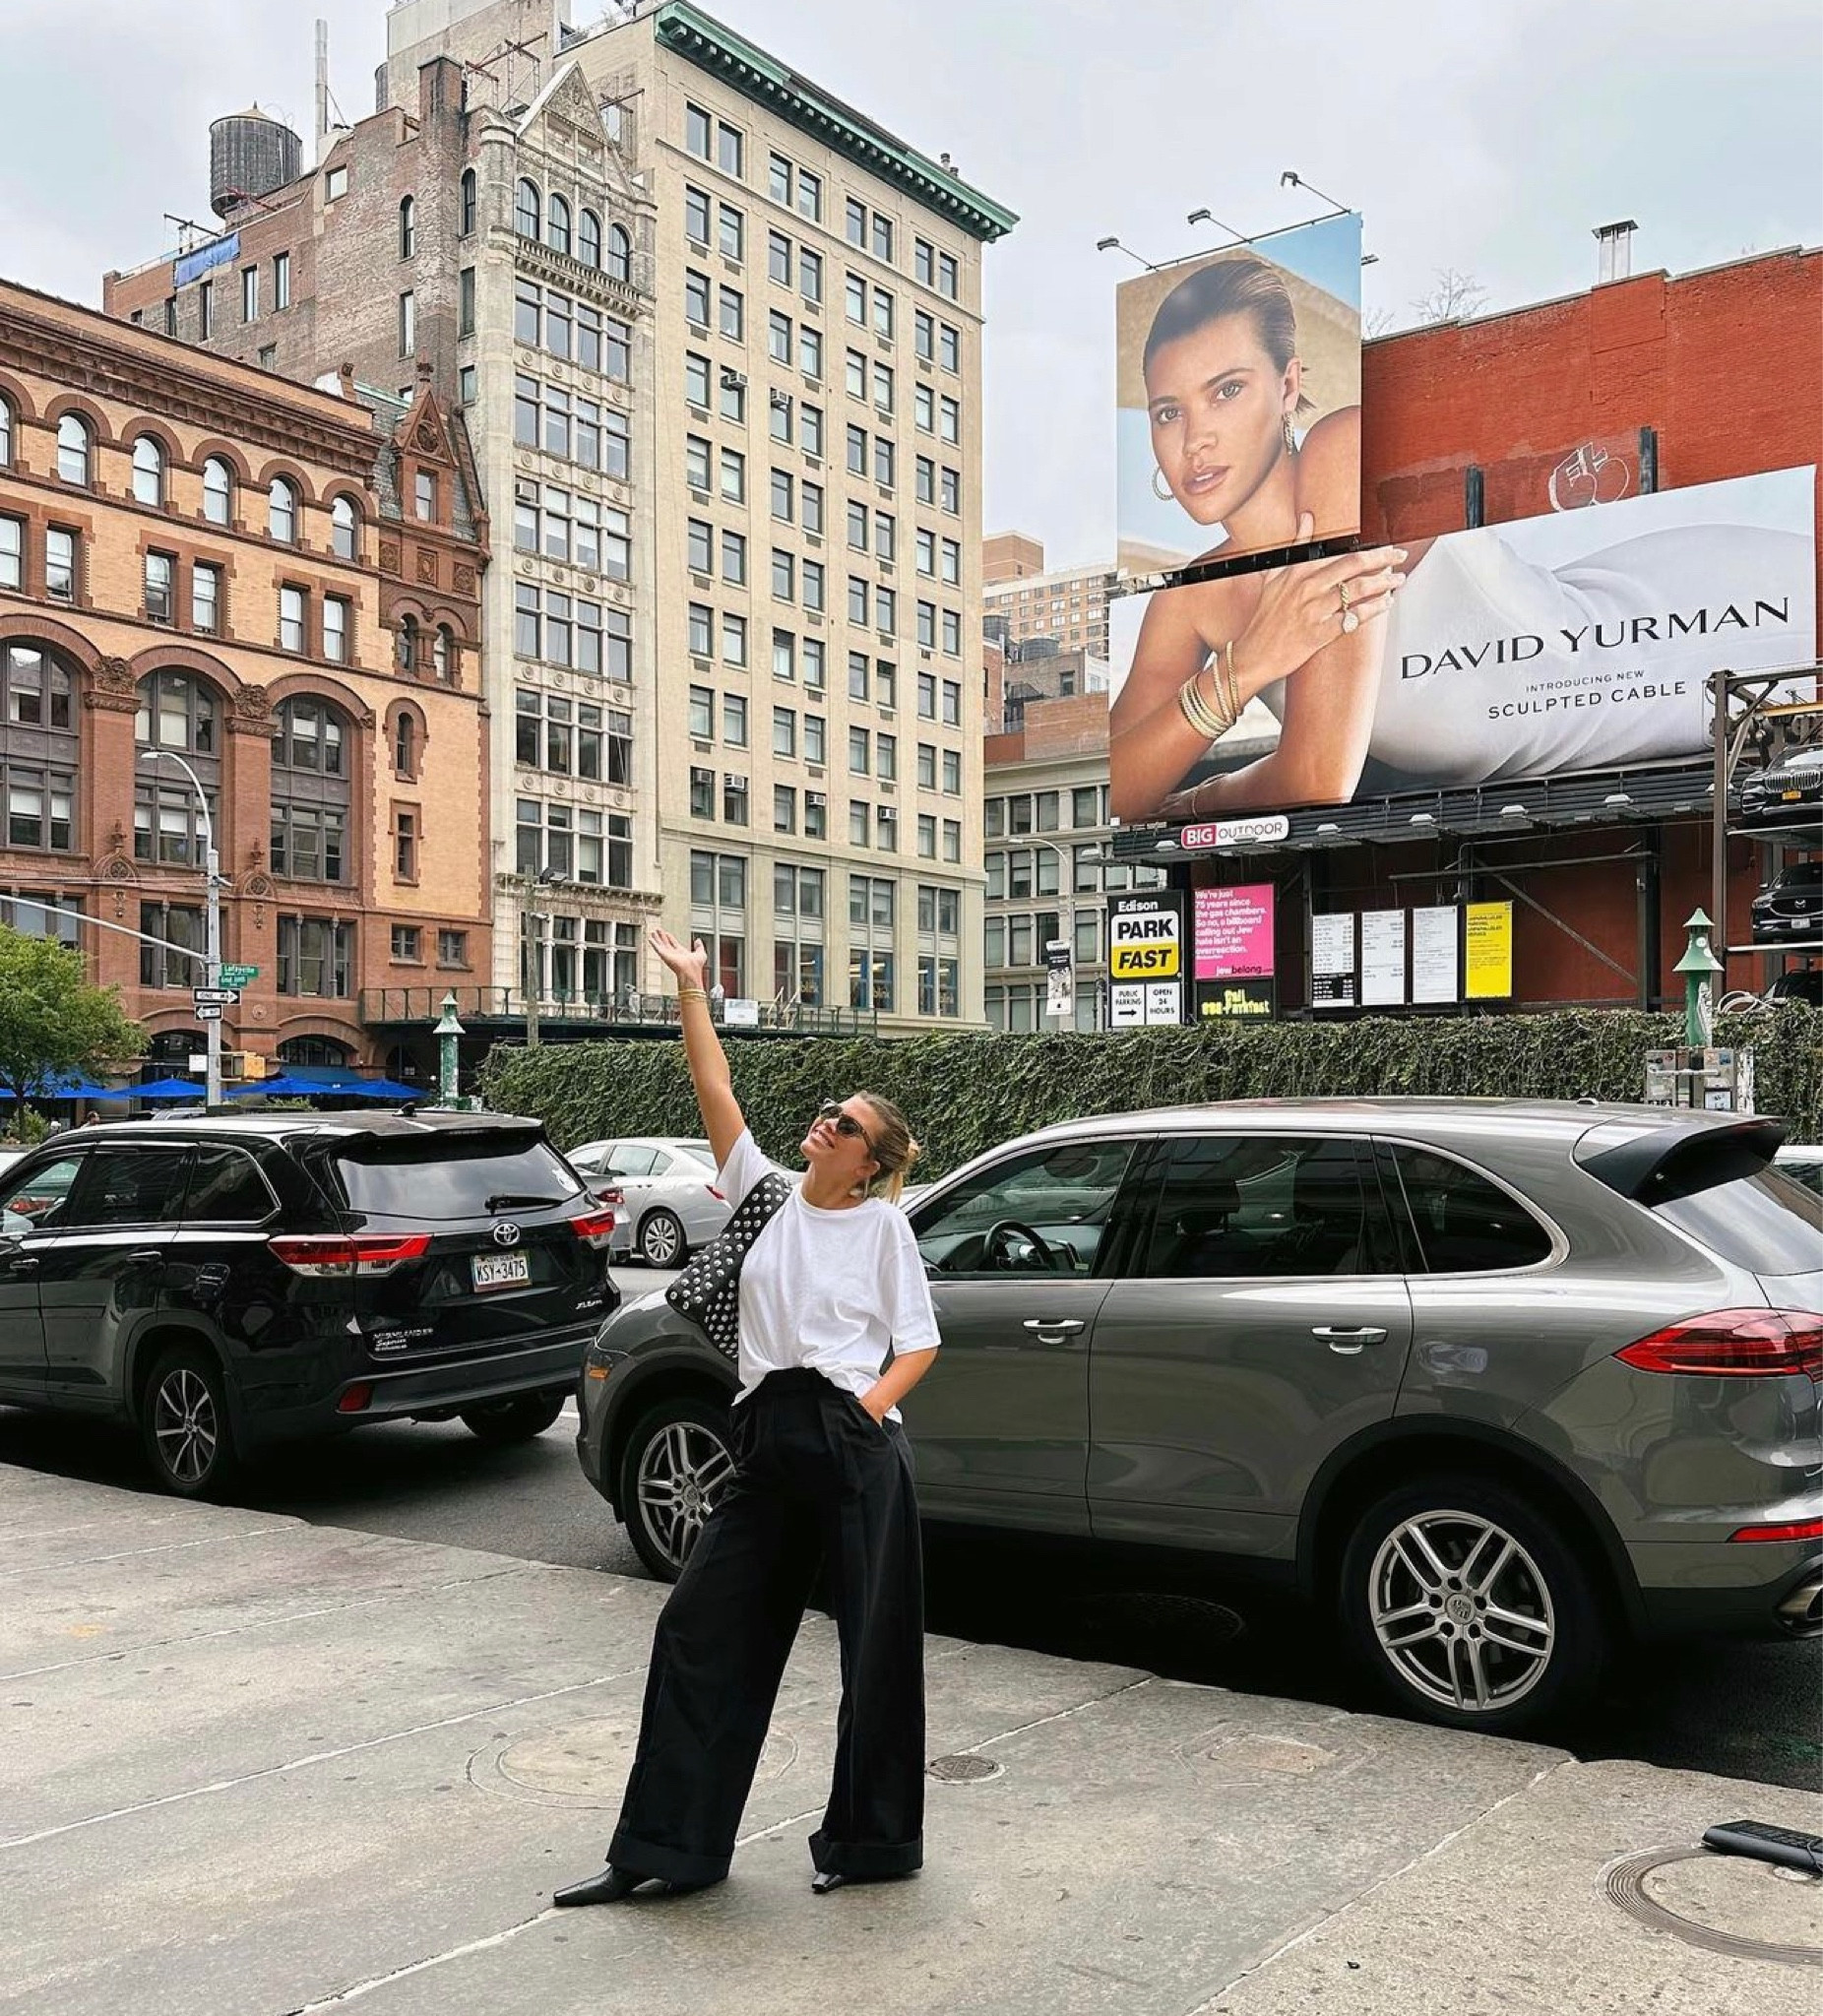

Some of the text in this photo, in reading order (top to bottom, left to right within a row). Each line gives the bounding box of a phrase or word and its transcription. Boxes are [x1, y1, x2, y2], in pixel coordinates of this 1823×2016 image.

[1401, 597, 1789, 680] DAVID YURMAN
[1525, 669, 1645, 693] INTRODUCING NEW
[1488, 680, 1686, 720] SCULPTED CABLE
[1186, 827, 1214, 845] BIG
[1117, 899, 1159, 913] Edison
[1117, 917, 1174, 940] PARK
[1118, 949, 1172, 971] FAST
[1150, 1006, 1175, 1015] HOURS
